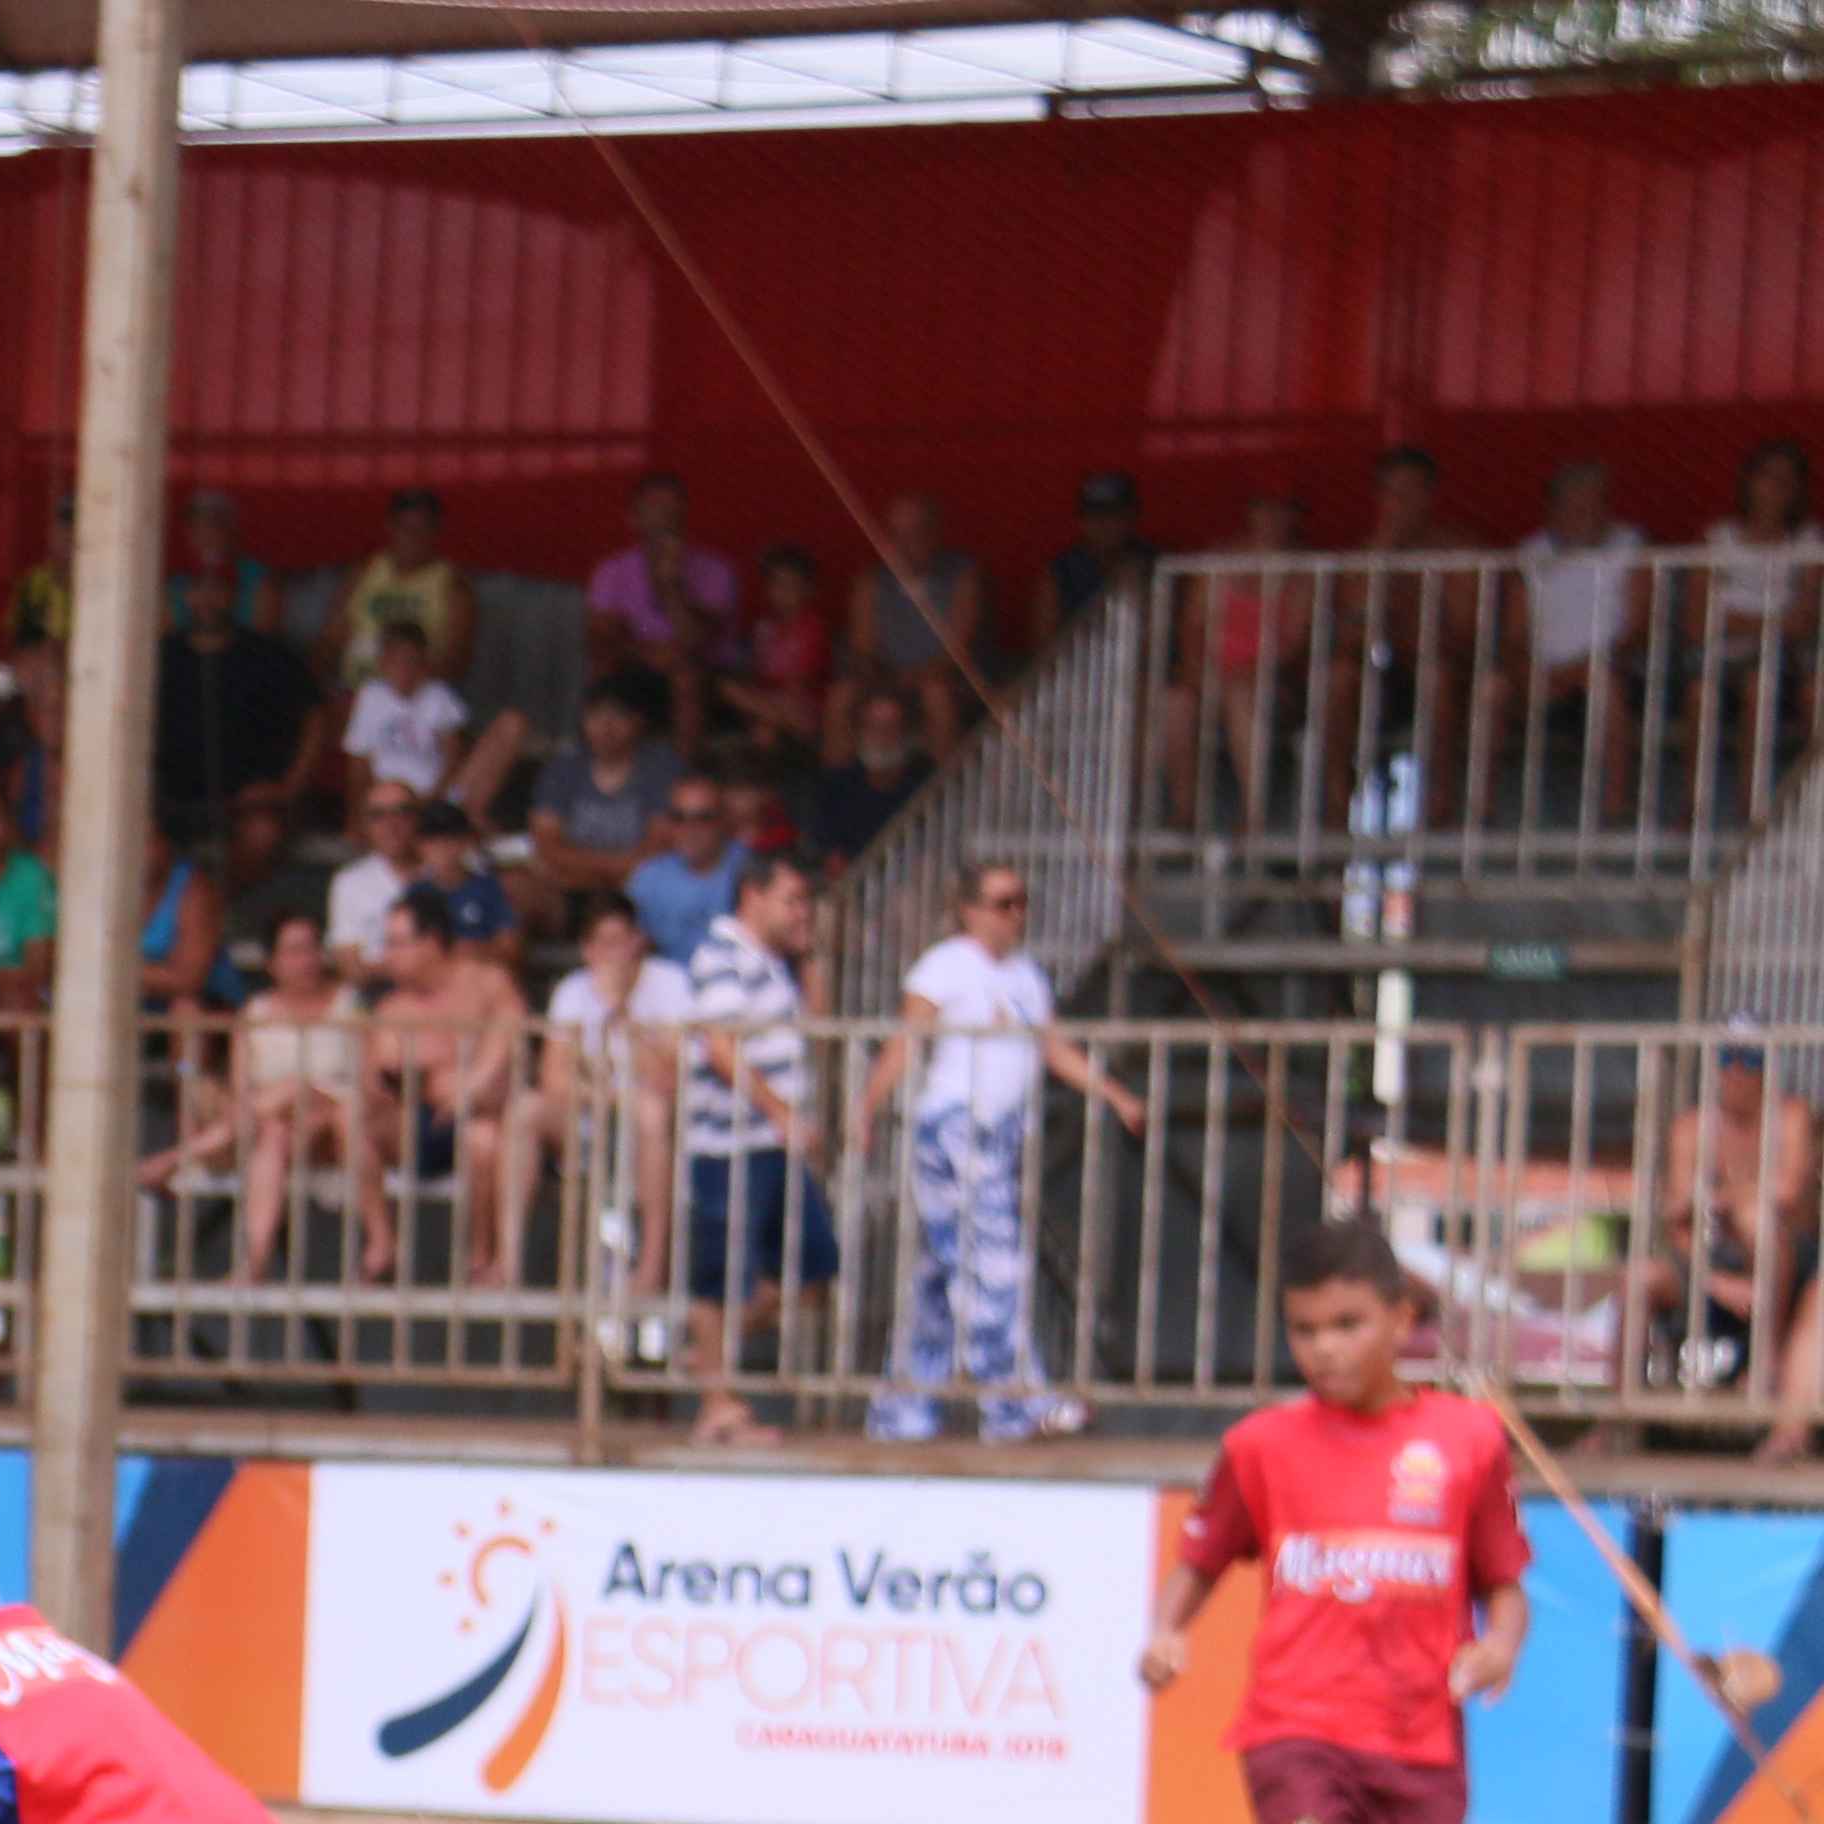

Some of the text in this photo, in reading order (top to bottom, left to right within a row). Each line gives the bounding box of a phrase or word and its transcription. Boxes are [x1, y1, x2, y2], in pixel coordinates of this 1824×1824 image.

[604, 1540, 1048, 1616] Arena Verão
[580, 1615, 1066, 1721] ESPORTIVA
